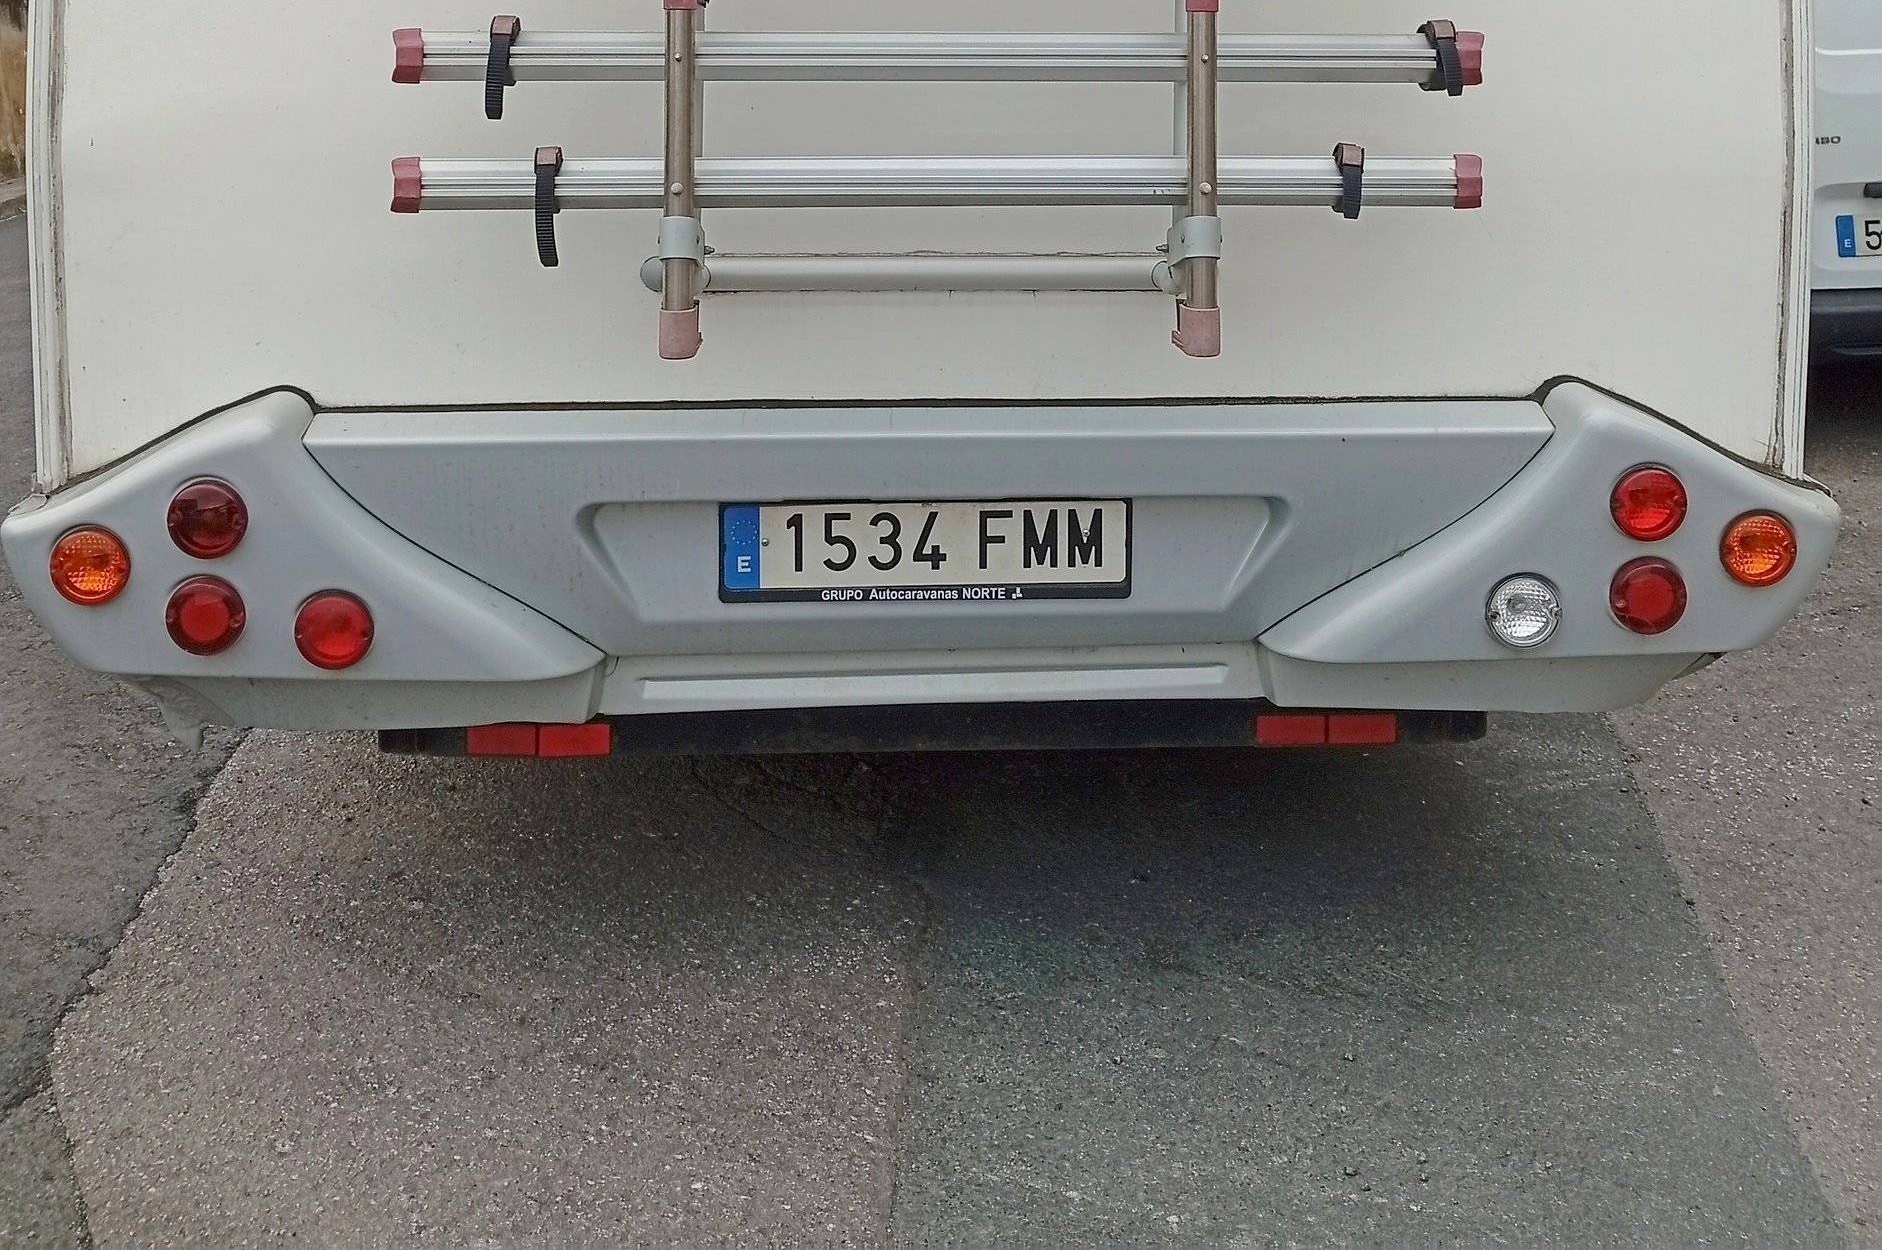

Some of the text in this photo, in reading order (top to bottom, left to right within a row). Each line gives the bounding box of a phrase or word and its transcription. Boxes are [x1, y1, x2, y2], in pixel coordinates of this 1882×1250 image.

[737, 508, 1104, 573] E 1534 FMM
[821, 587, 1006, 601] GRUPO Autocaravanas NORTE
